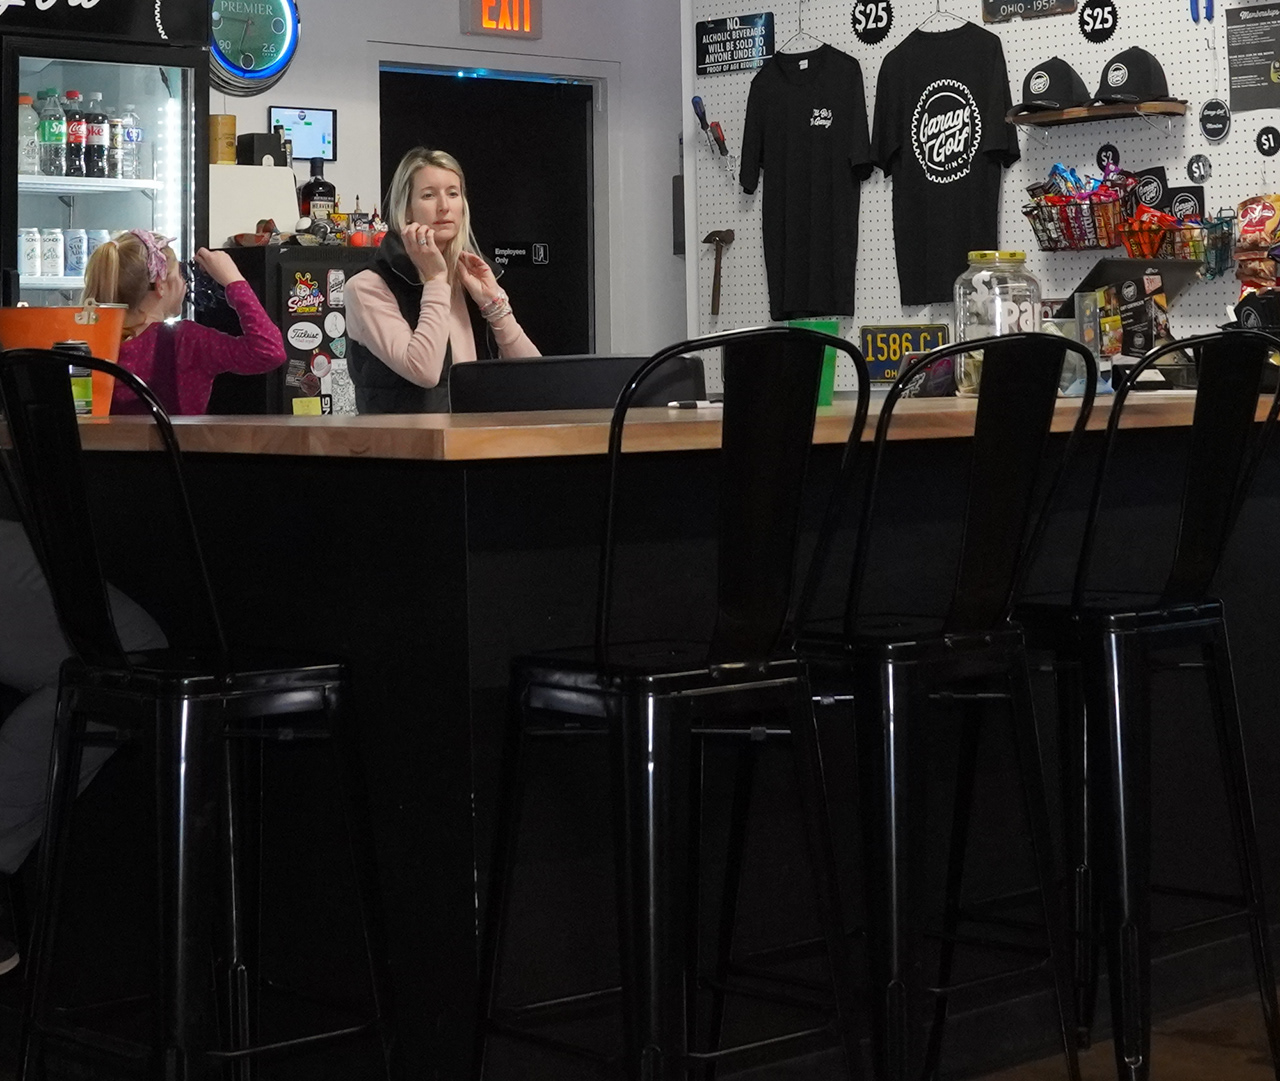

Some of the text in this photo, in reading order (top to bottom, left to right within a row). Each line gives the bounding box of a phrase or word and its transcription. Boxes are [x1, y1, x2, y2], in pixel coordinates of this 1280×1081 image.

[221, 1, 273, 15] PREMIER
[1001, 3, 1024, 16] OHIO
[1240, 9, 1280, 19] Memberships
[727, 17, 740, 30] NO
[854, 1, 888, 33] $25
[1083, 6, 1112, 32] $25
[702, 27, 765, 43] ALCHOLIC BEVERAGES
[219, 40, 231, 49] 90
[263, 43, 275, 52] 2.6
[708, 37, 764, 53] WILL BE SOLD TO
[705, 46, 766, 63] ANYONE UNDER 21
[919, 106, 971, 142] Garage
[933, 126, 969, 162] Golf
[1261, 134, 1274, 150] $1
[945, 153, 968, 171] CINCY
[1101, 151, 1113, 165] $2
[1192, 162, 1205, 177] $1
[495, 247, 526, 256] Employees
[495, 256, 509, 265] Only
[288, 294, 325, 312] Scotty's
[291, 329, 319, 339] Titleist
[865, 333, 912, 362] 1586
